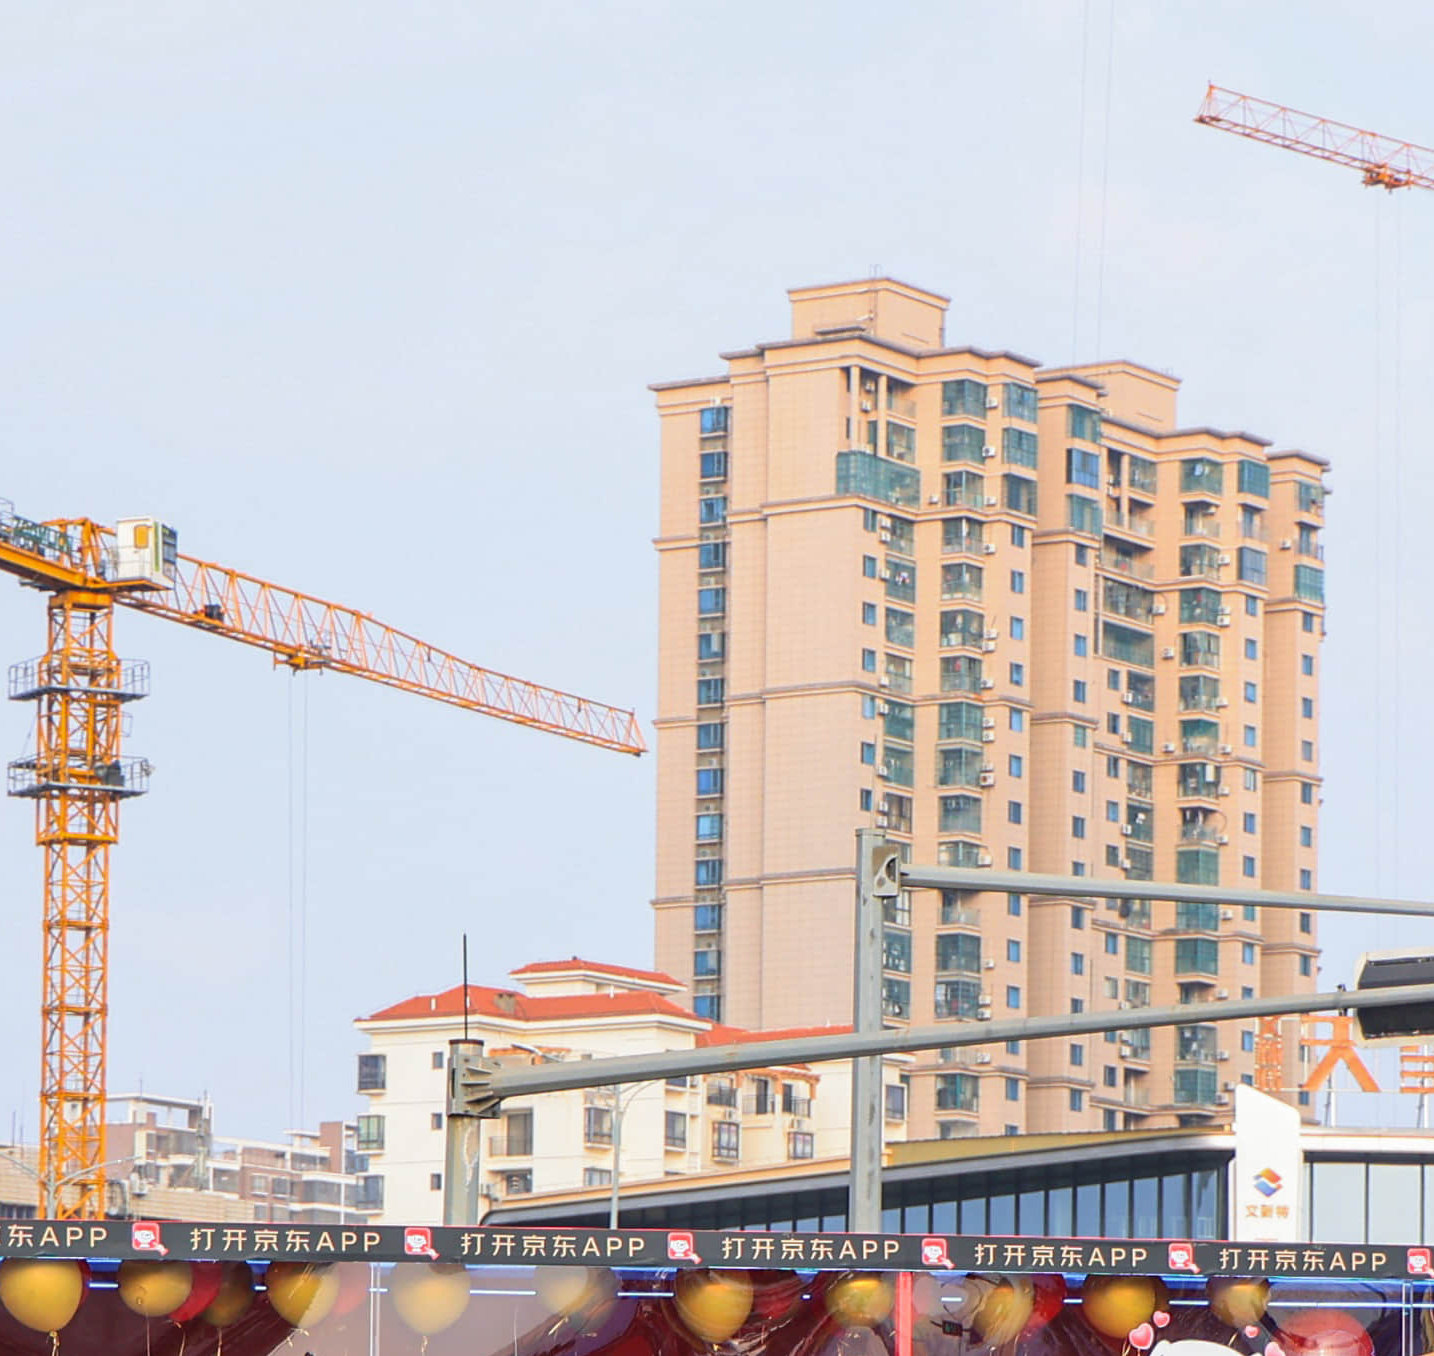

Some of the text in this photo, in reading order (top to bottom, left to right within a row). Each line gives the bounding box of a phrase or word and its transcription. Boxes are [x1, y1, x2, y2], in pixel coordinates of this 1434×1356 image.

[190, 1227, 381, 1252] 打开京东APP
[461, 1232, 645, 1258] 打开京东APP
[722, 1237, 900, 1261] 打开京东APP
[974, 1243, 1148, 1268] 打开京东APP
[1219, 1248, 1386, 1273] 打开京东APP
